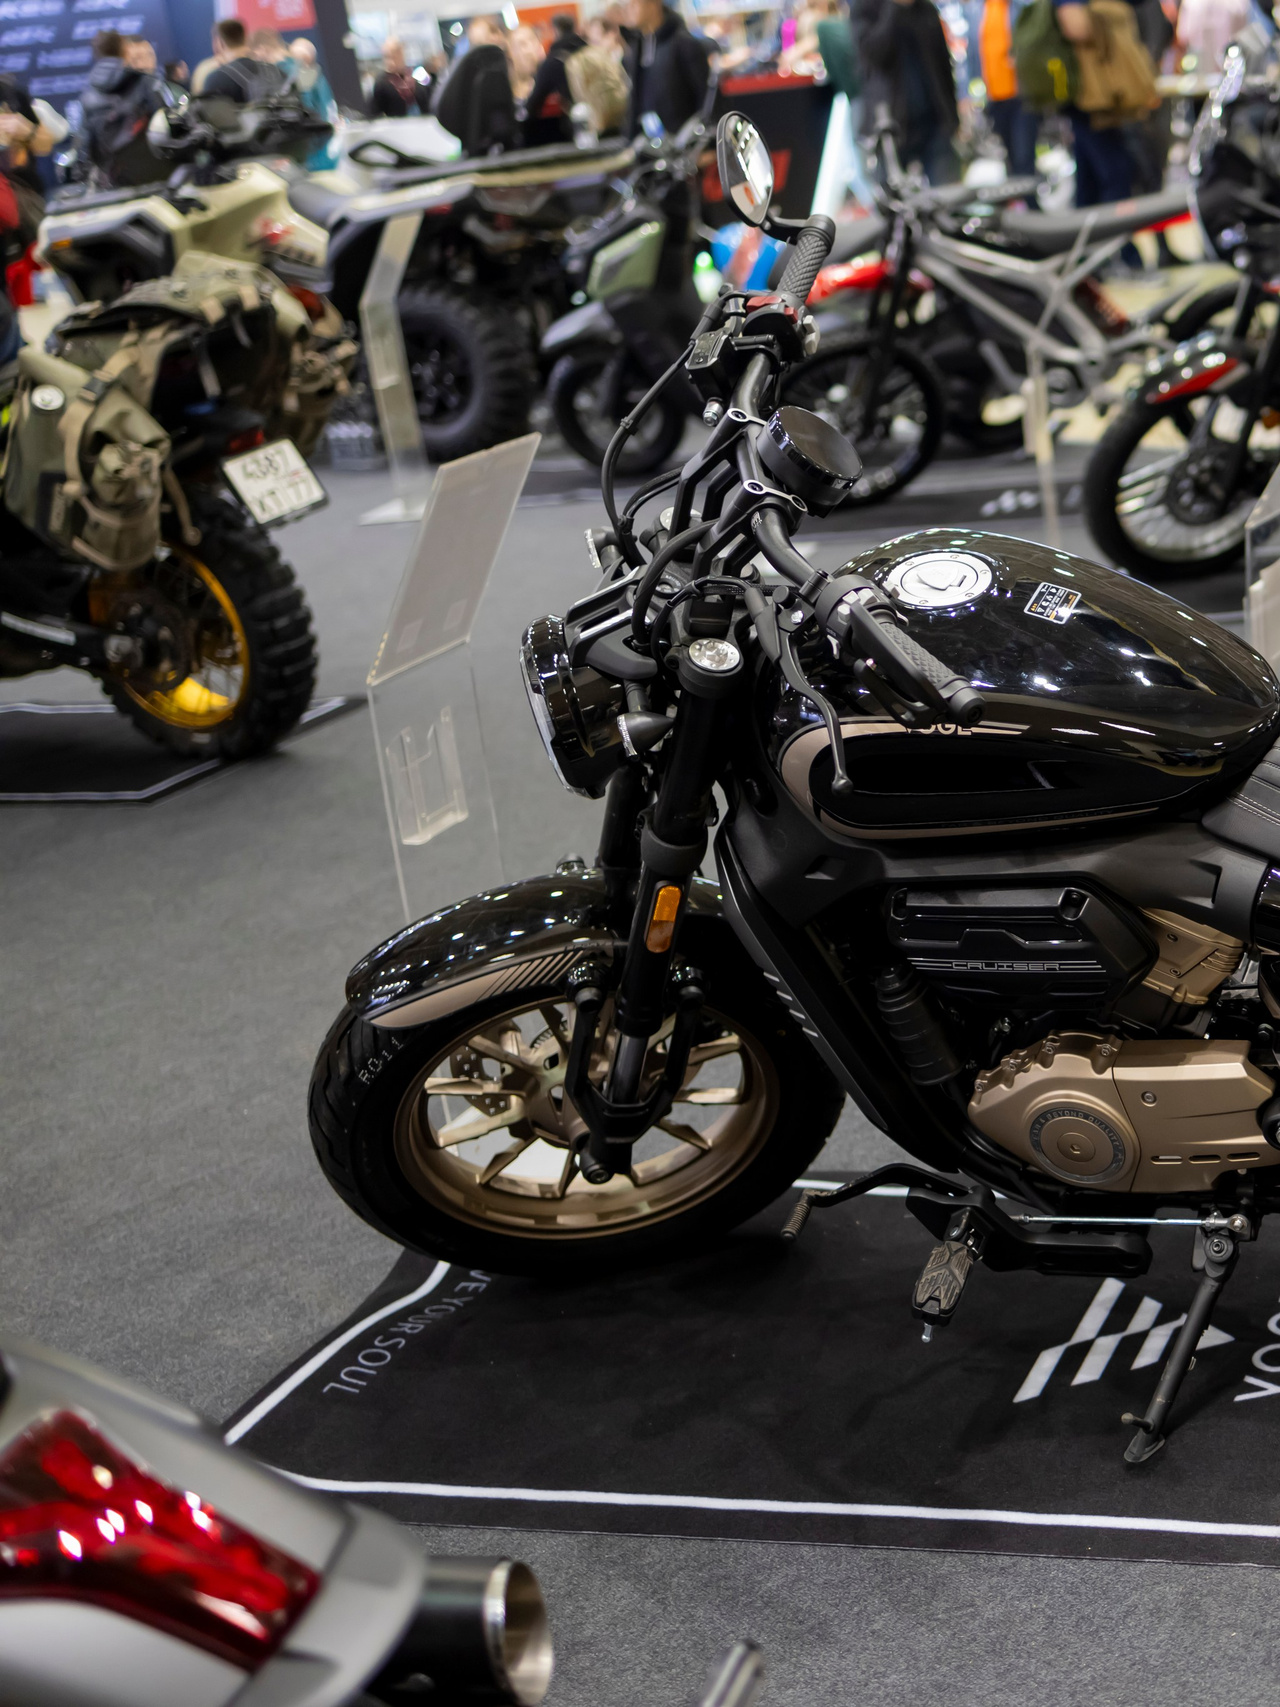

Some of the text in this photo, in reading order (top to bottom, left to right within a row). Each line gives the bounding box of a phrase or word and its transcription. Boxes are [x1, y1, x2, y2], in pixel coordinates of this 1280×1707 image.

[952, 962, 1059, 971] CRUISER
[1046, 1110, 1084, 1120] BEYOND
[1088, 1116, 1120, 1146] QUALITY
[389, 1296, 474, 1334] YOUR
[322, 1335, 406, 1394] SOUL
